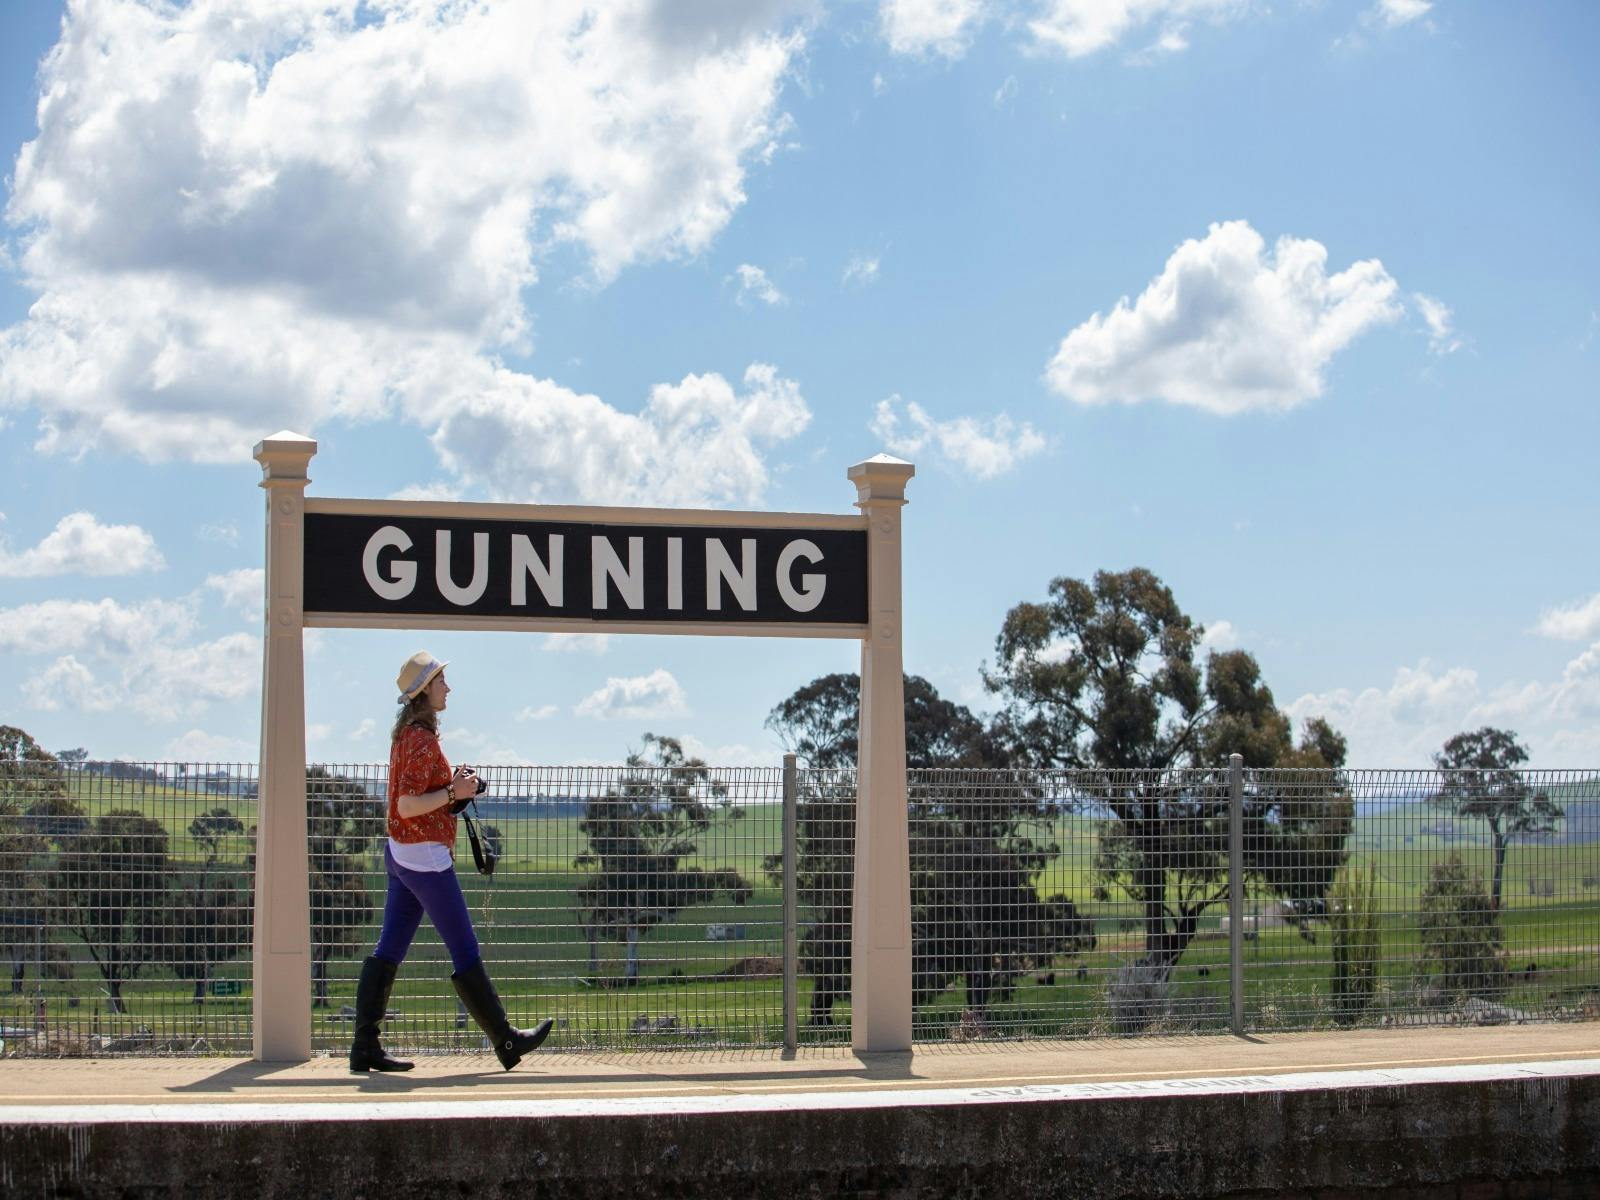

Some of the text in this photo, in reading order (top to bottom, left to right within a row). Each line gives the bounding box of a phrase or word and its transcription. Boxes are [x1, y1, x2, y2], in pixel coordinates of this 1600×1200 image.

[362, 525, 827, 613] GUNNING
[972, 1077, 1275, 1098] MIND THE GAP
